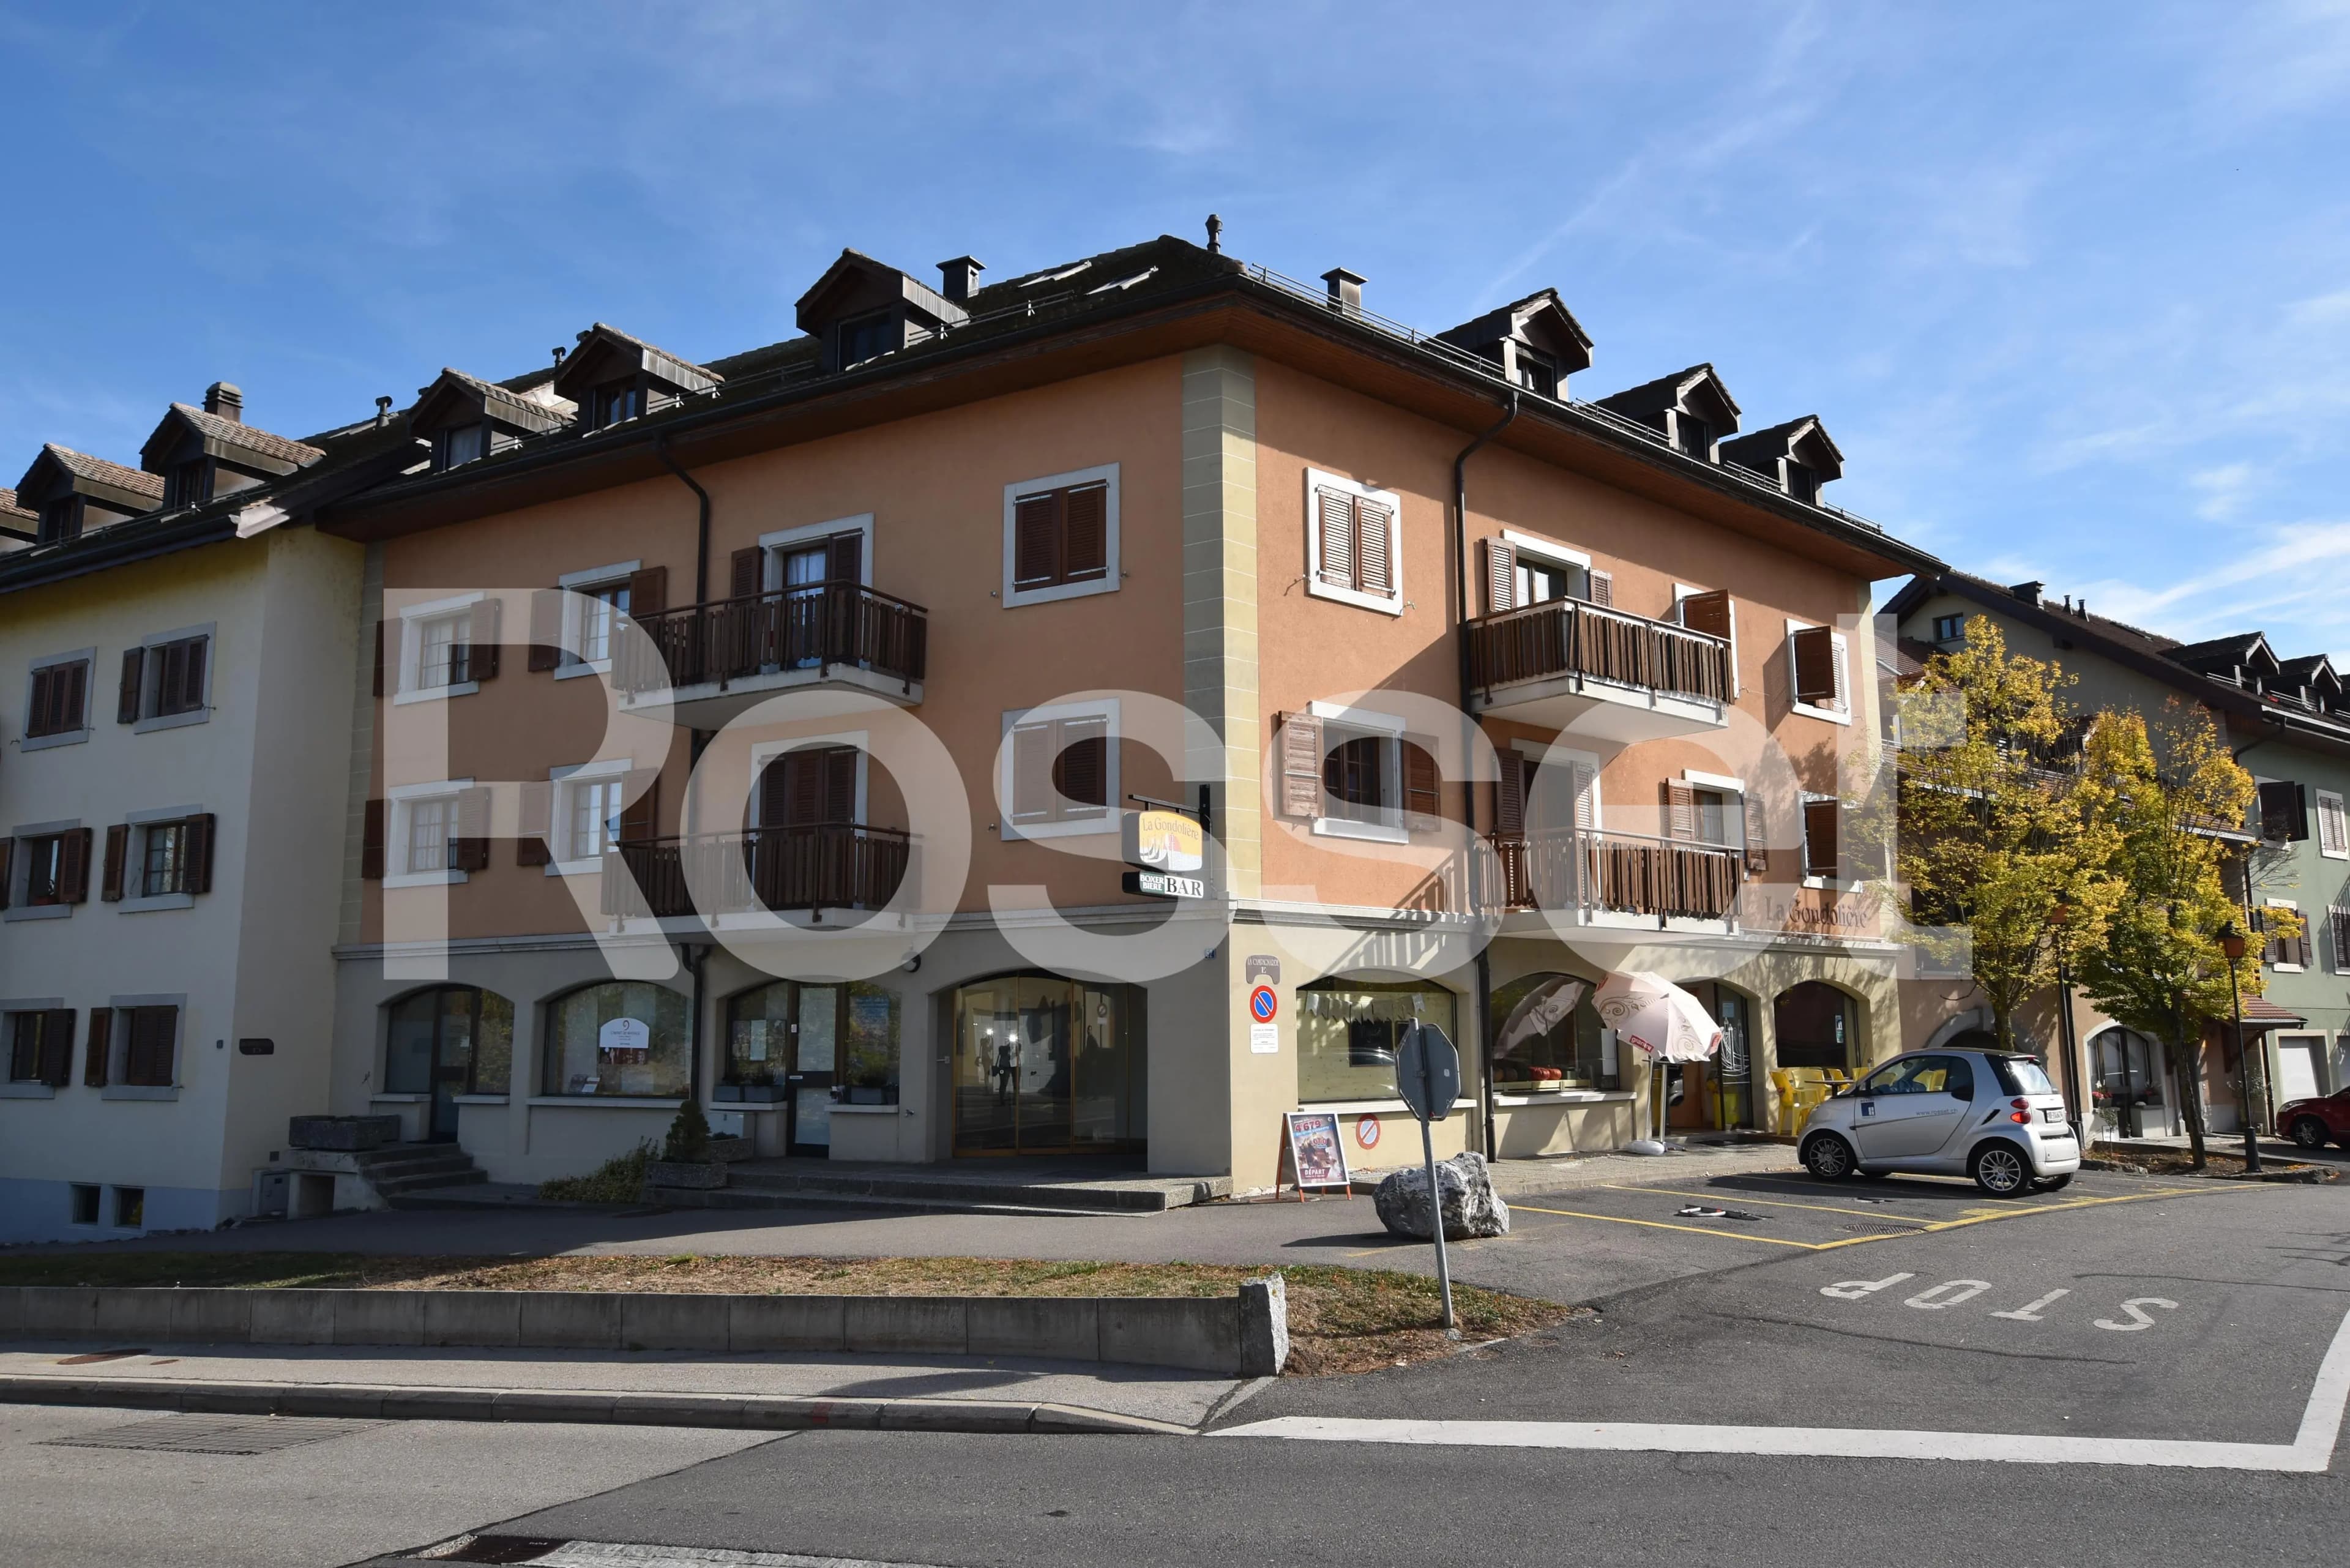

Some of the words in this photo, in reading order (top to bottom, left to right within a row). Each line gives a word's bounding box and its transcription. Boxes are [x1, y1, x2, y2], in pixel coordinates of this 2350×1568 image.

[1143, 818, 1153, 832] La
[1154, 817, 1199, 840] Gondolière
[1140, 874, 1164, 884] BOXER
[1166, 878, 1203, 897] BAR
[1765, 896, 1785, 921] La
[1789, 898, 1867, 928] Gondolière
[1820, 1272, 2179, 1331] STOP
